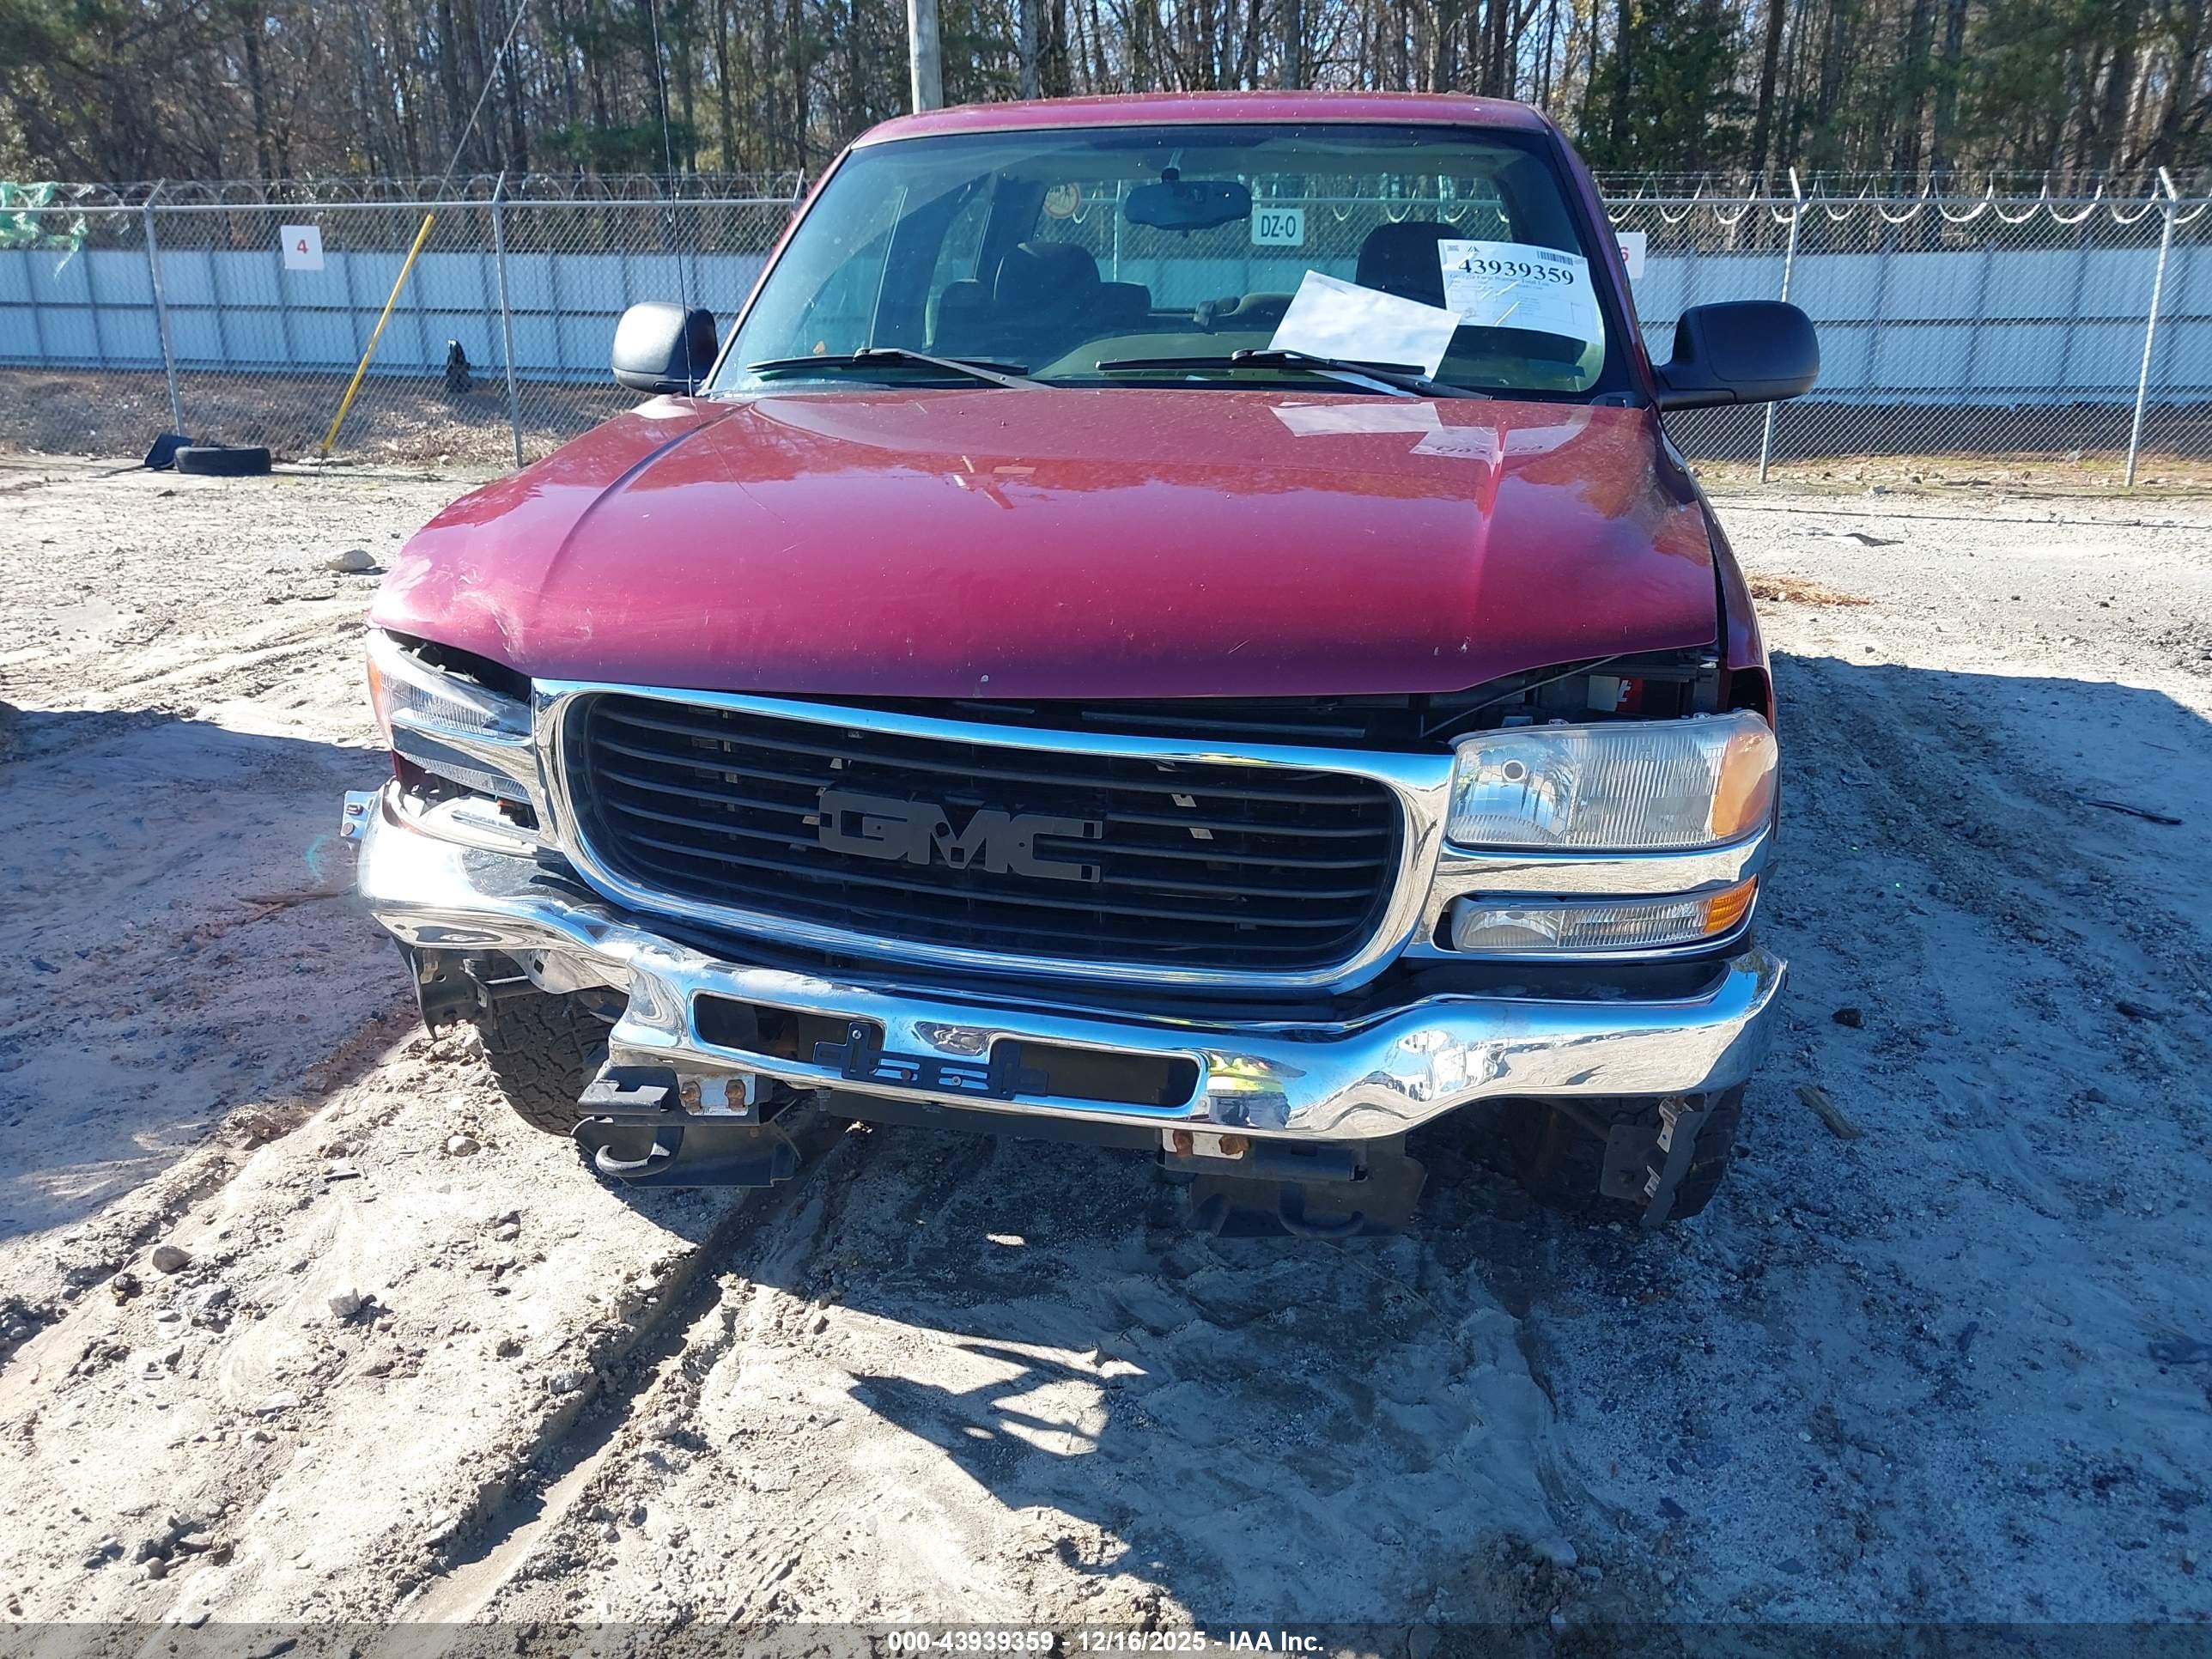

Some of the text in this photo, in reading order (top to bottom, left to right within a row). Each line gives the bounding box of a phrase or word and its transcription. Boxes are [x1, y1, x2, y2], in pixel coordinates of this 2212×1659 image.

[296, 239, 309, 254] 4
[1458, 258, 1574, 286] 43939359
[818, 789, 1103, 884] GMC
